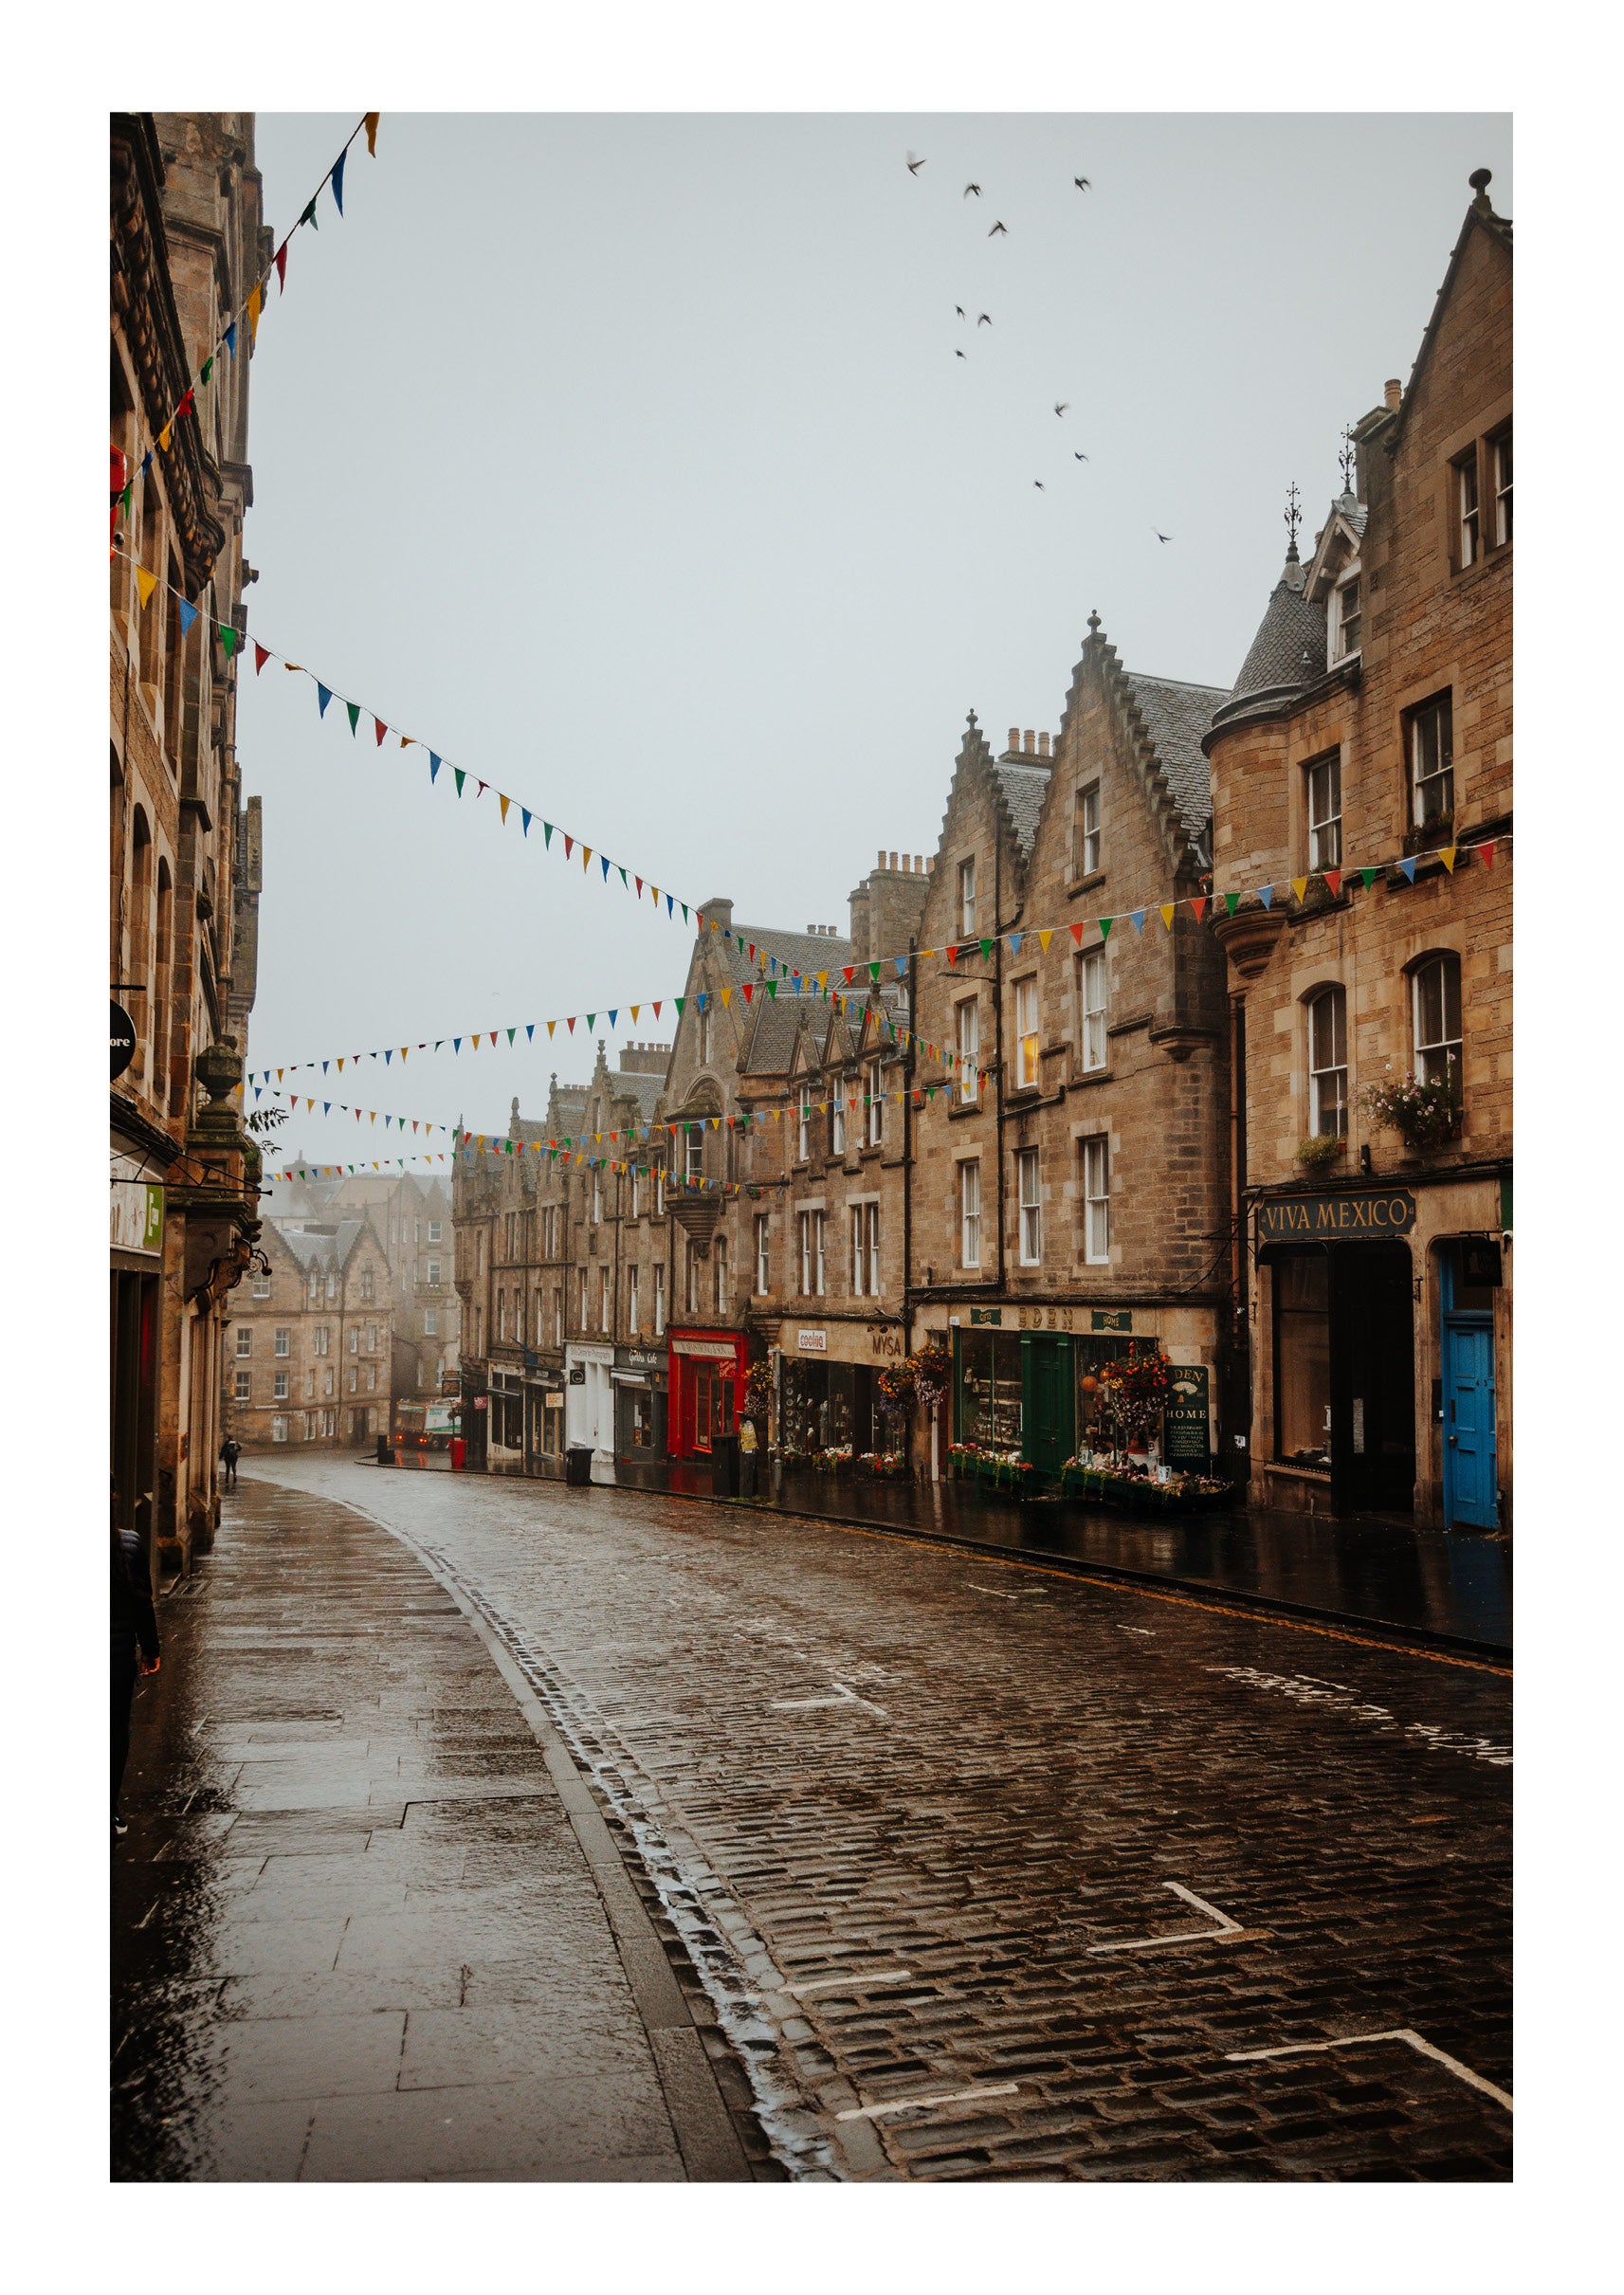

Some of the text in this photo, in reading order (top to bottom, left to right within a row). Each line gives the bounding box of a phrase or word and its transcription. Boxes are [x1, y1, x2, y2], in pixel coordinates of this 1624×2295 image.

[1266, 1205, 1310, 1230] VIVA
[1316, 1198, 1407, 1229] MEXICO
[1018, 1306, 1073, 1330] EDEN
[1103, 1316, 1120, 1327] HOME
[872, 1335, 902, 1357] MYSA
[1174, 1369, 1204, 1383] DEN
[1166, 1410, 1207, 1420] HOME
